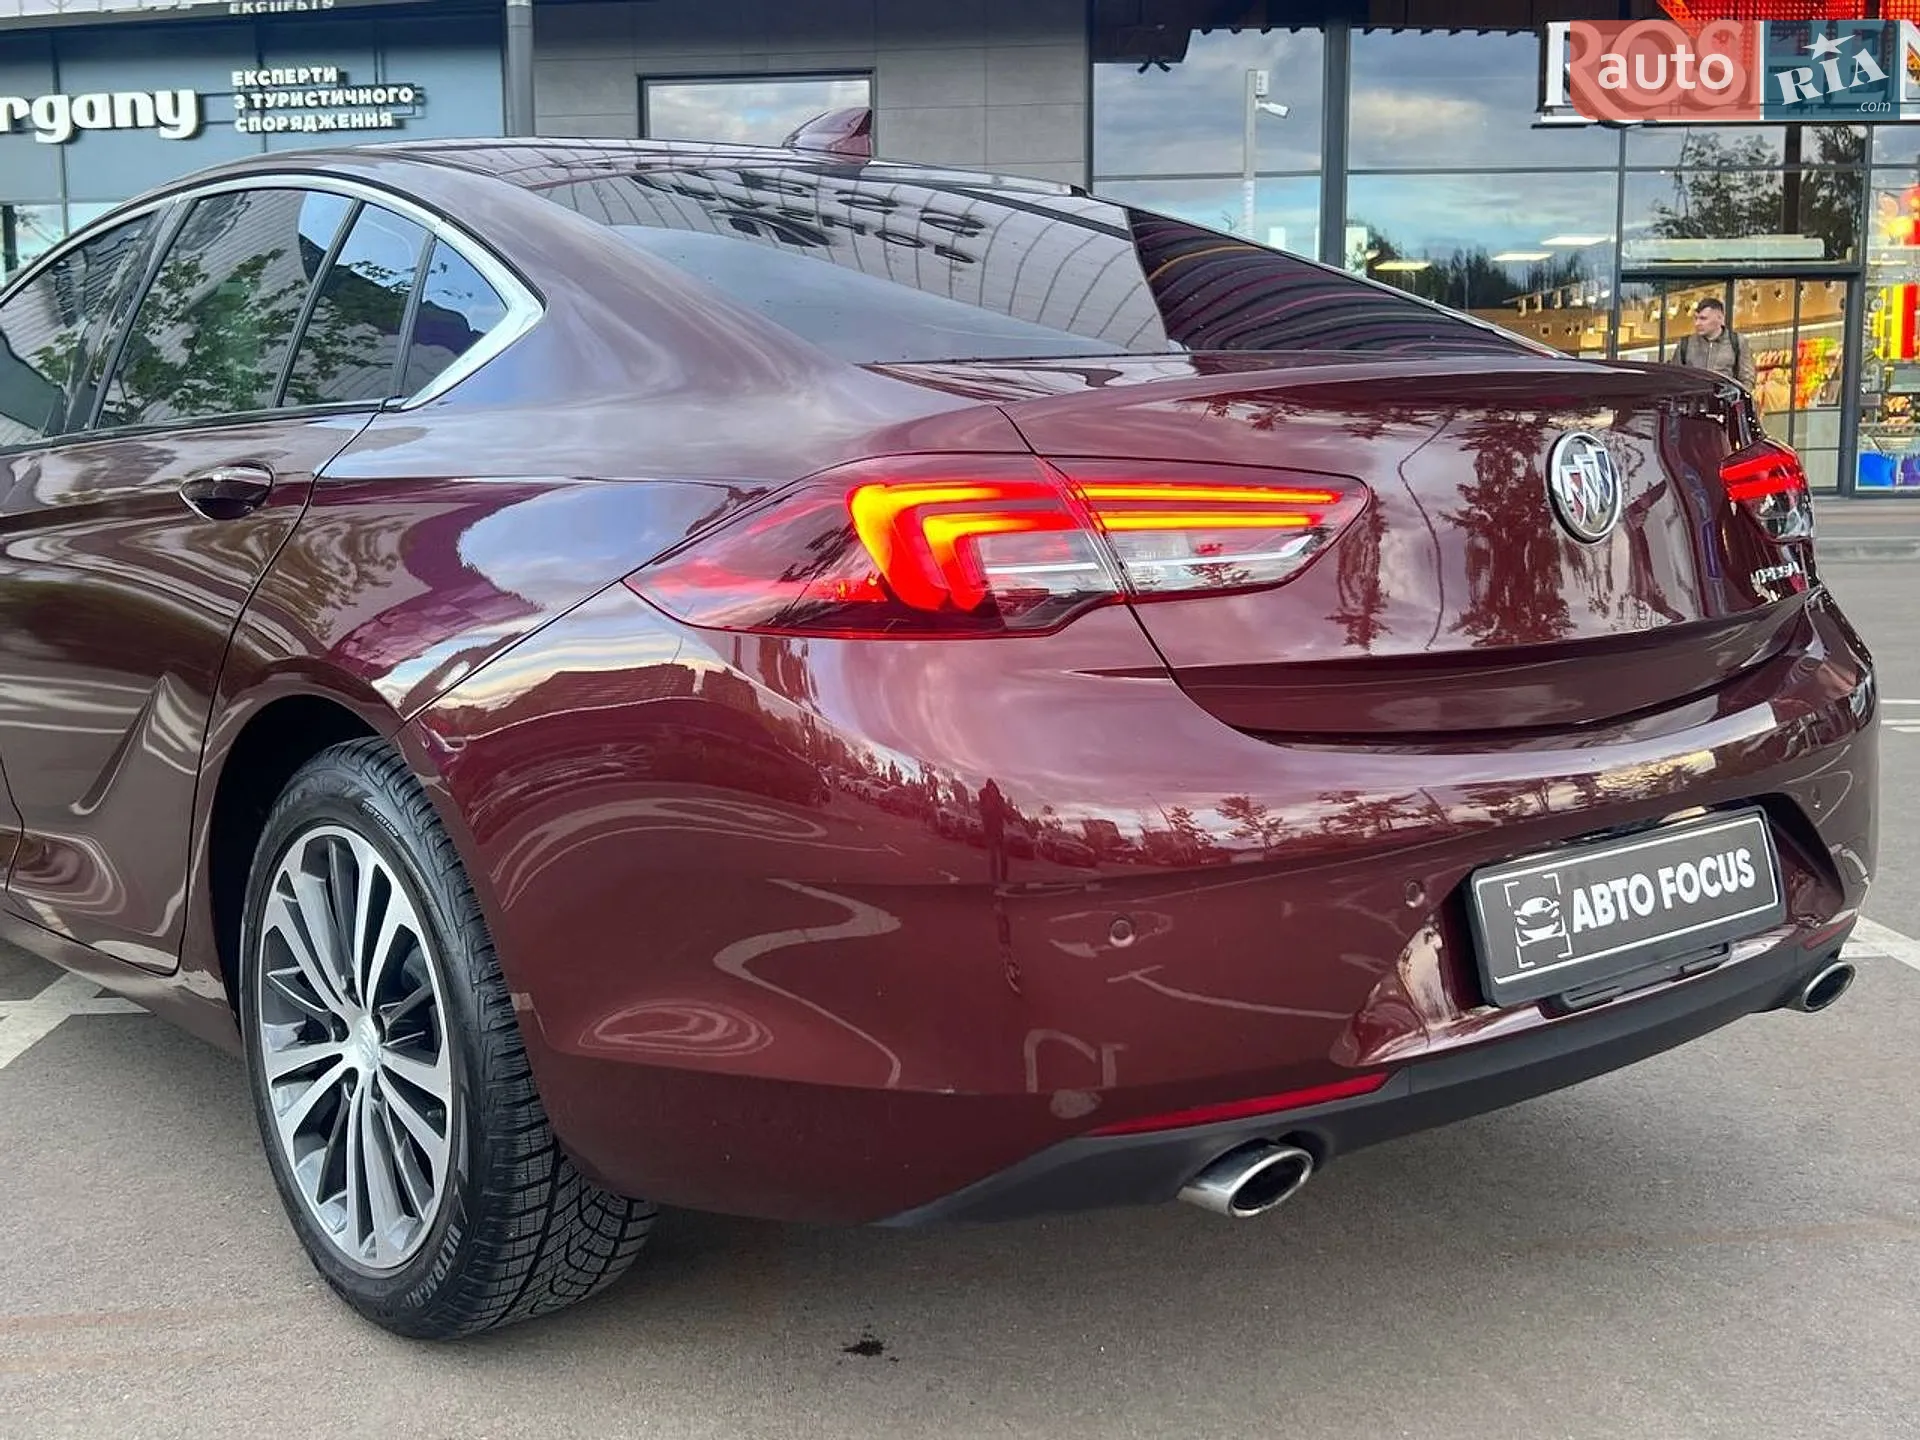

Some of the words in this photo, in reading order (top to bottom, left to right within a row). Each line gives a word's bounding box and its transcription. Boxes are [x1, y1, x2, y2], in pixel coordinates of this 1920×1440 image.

[231, 67, 338, 87] ЕКСПЕРТИ
[250, 87, 414, 109] ТУРИСТИЧНОГО
[0, 89, 197, 144] rgany
[234, 112, 393, 132] СПОРЯДЖЕННЯ
[1658, 848, 1756, 910] FOCUS
